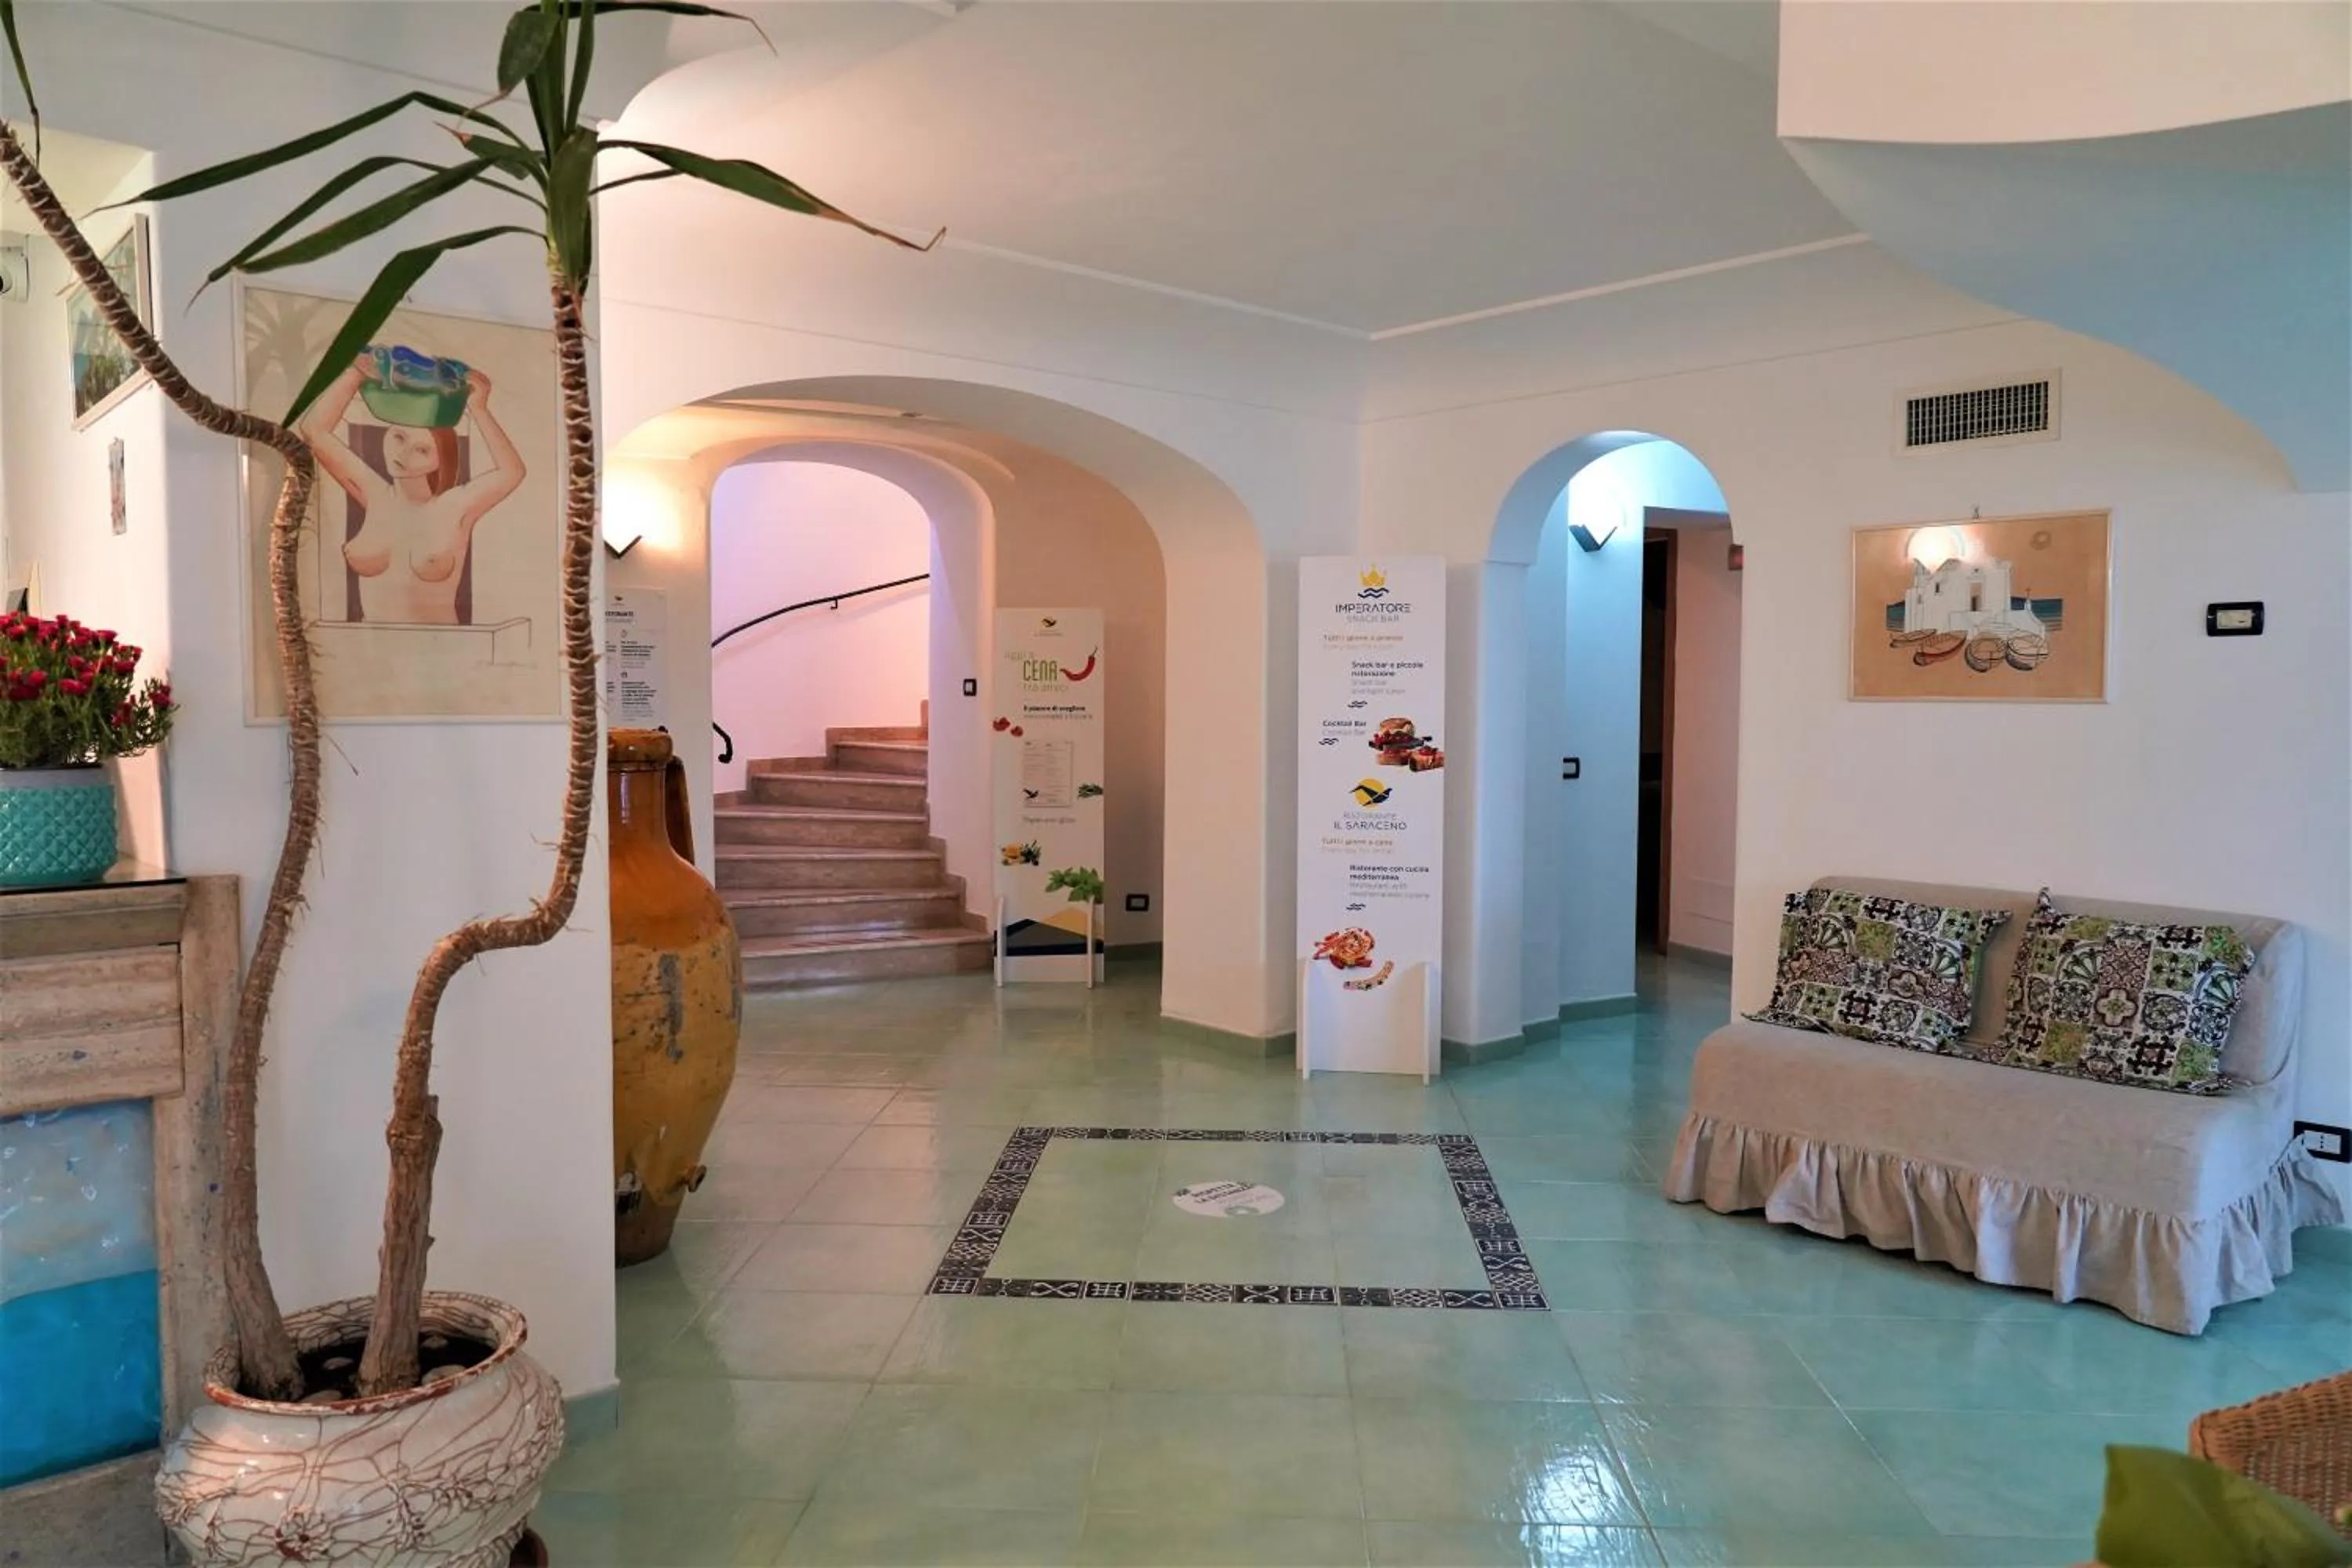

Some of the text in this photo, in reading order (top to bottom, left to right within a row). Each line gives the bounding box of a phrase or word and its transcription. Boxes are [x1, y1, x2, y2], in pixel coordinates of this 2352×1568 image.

[1335, 603, 1411, 613] IMPERATORE
[1023, 660, 1058, 681] CENA
[1345, 822, 1408, 830] SARACENO
